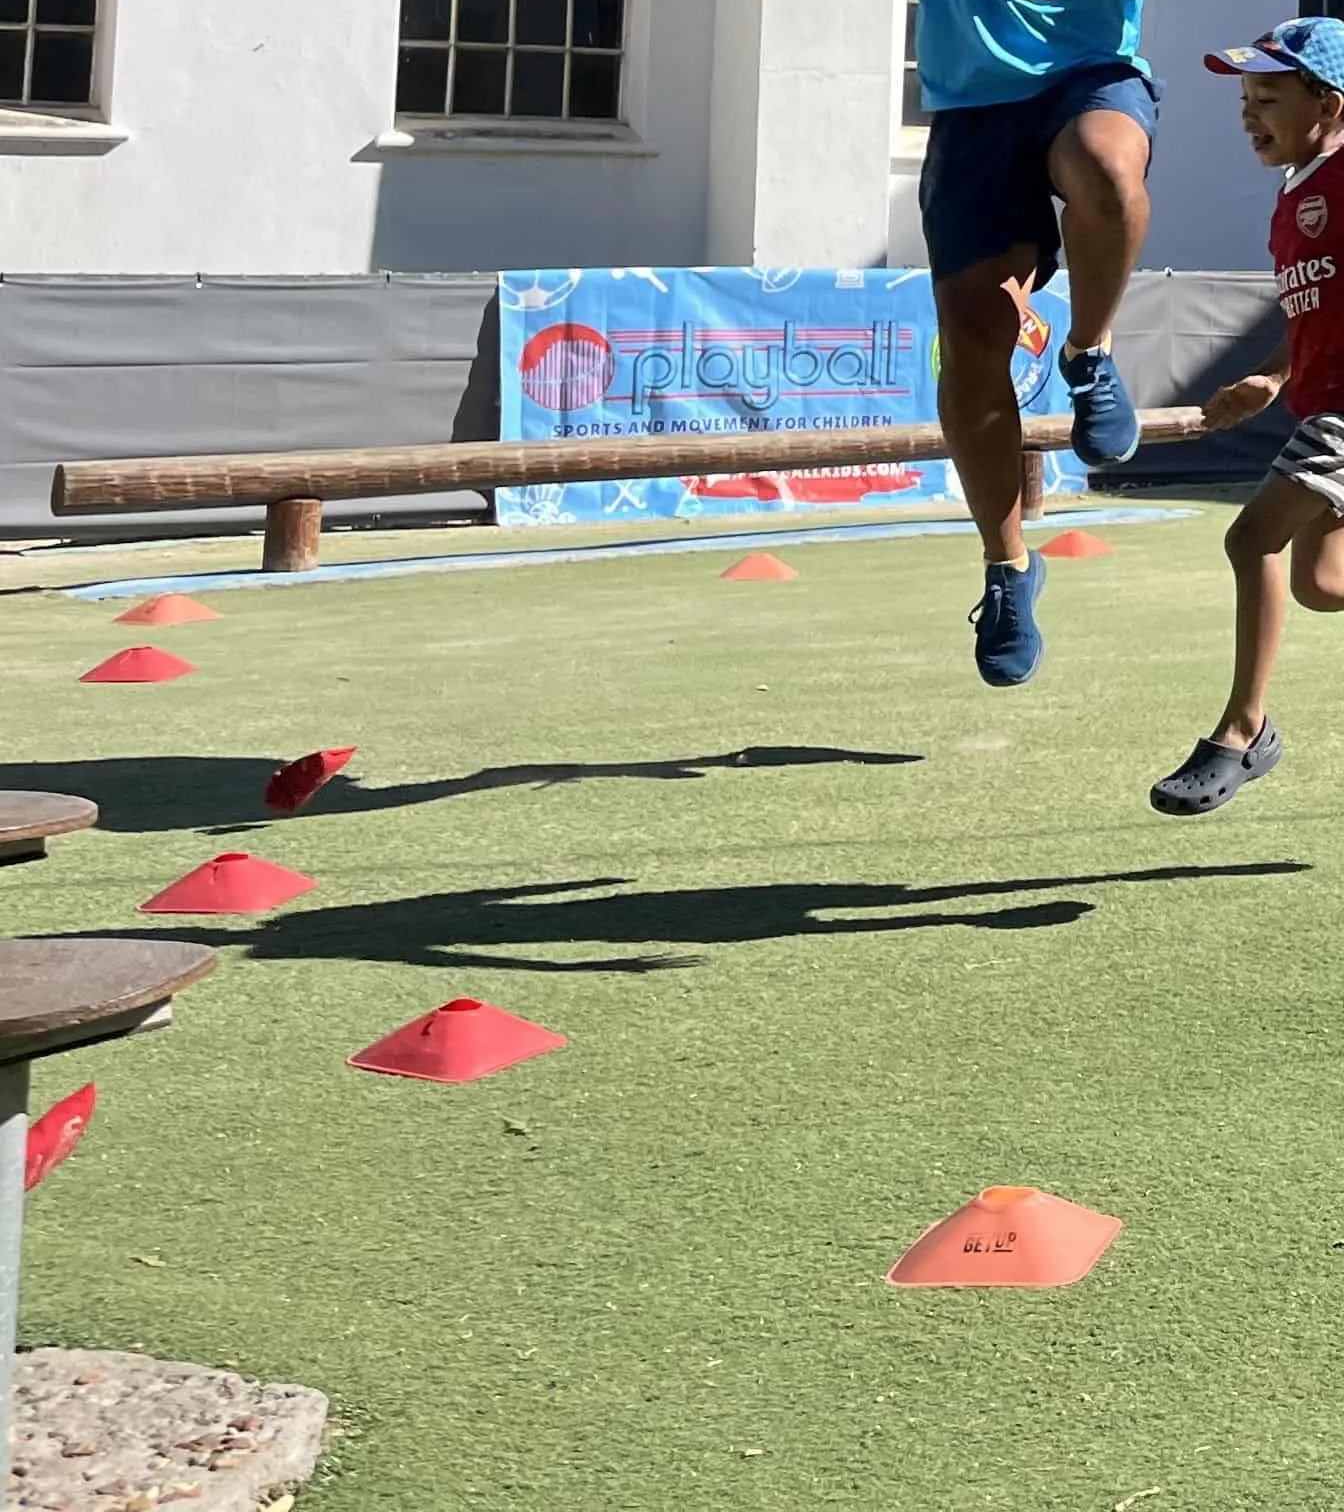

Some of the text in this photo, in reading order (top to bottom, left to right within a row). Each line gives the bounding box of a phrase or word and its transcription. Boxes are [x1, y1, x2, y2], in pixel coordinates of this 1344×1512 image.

[631, 320, 898, 416] playball
[553, 415, 893, 438] SPORTS AND MOVEMENT FOR CHILDREN
